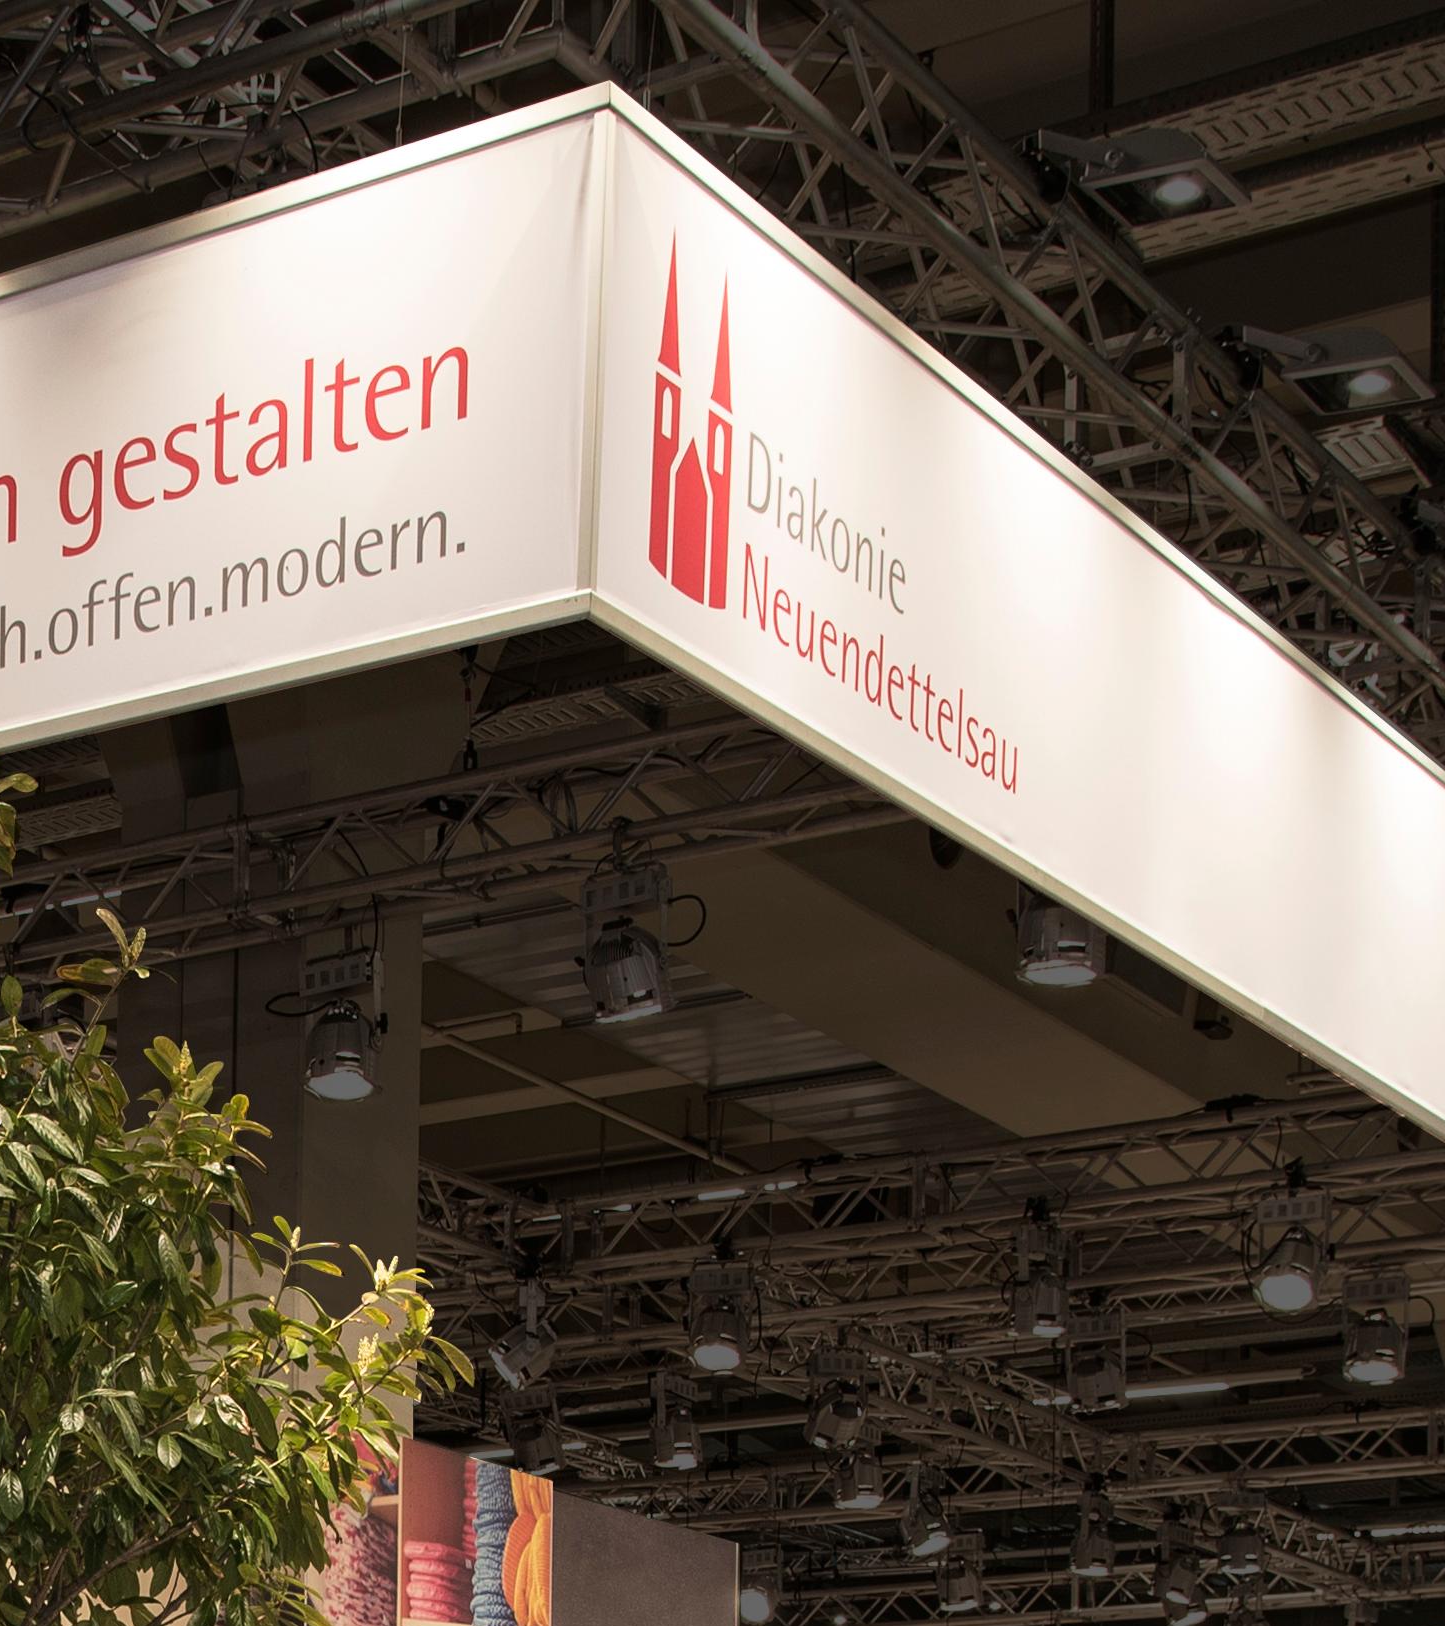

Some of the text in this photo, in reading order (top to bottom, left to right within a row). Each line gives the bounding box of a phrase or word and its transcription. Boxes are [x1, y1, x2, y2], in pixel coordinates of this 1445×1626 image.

[56, 344, 470, 558] gestalten
[746, 432, 910, 616] Diakonie
[742, 540, 1020, 796] Neuendettelsau
